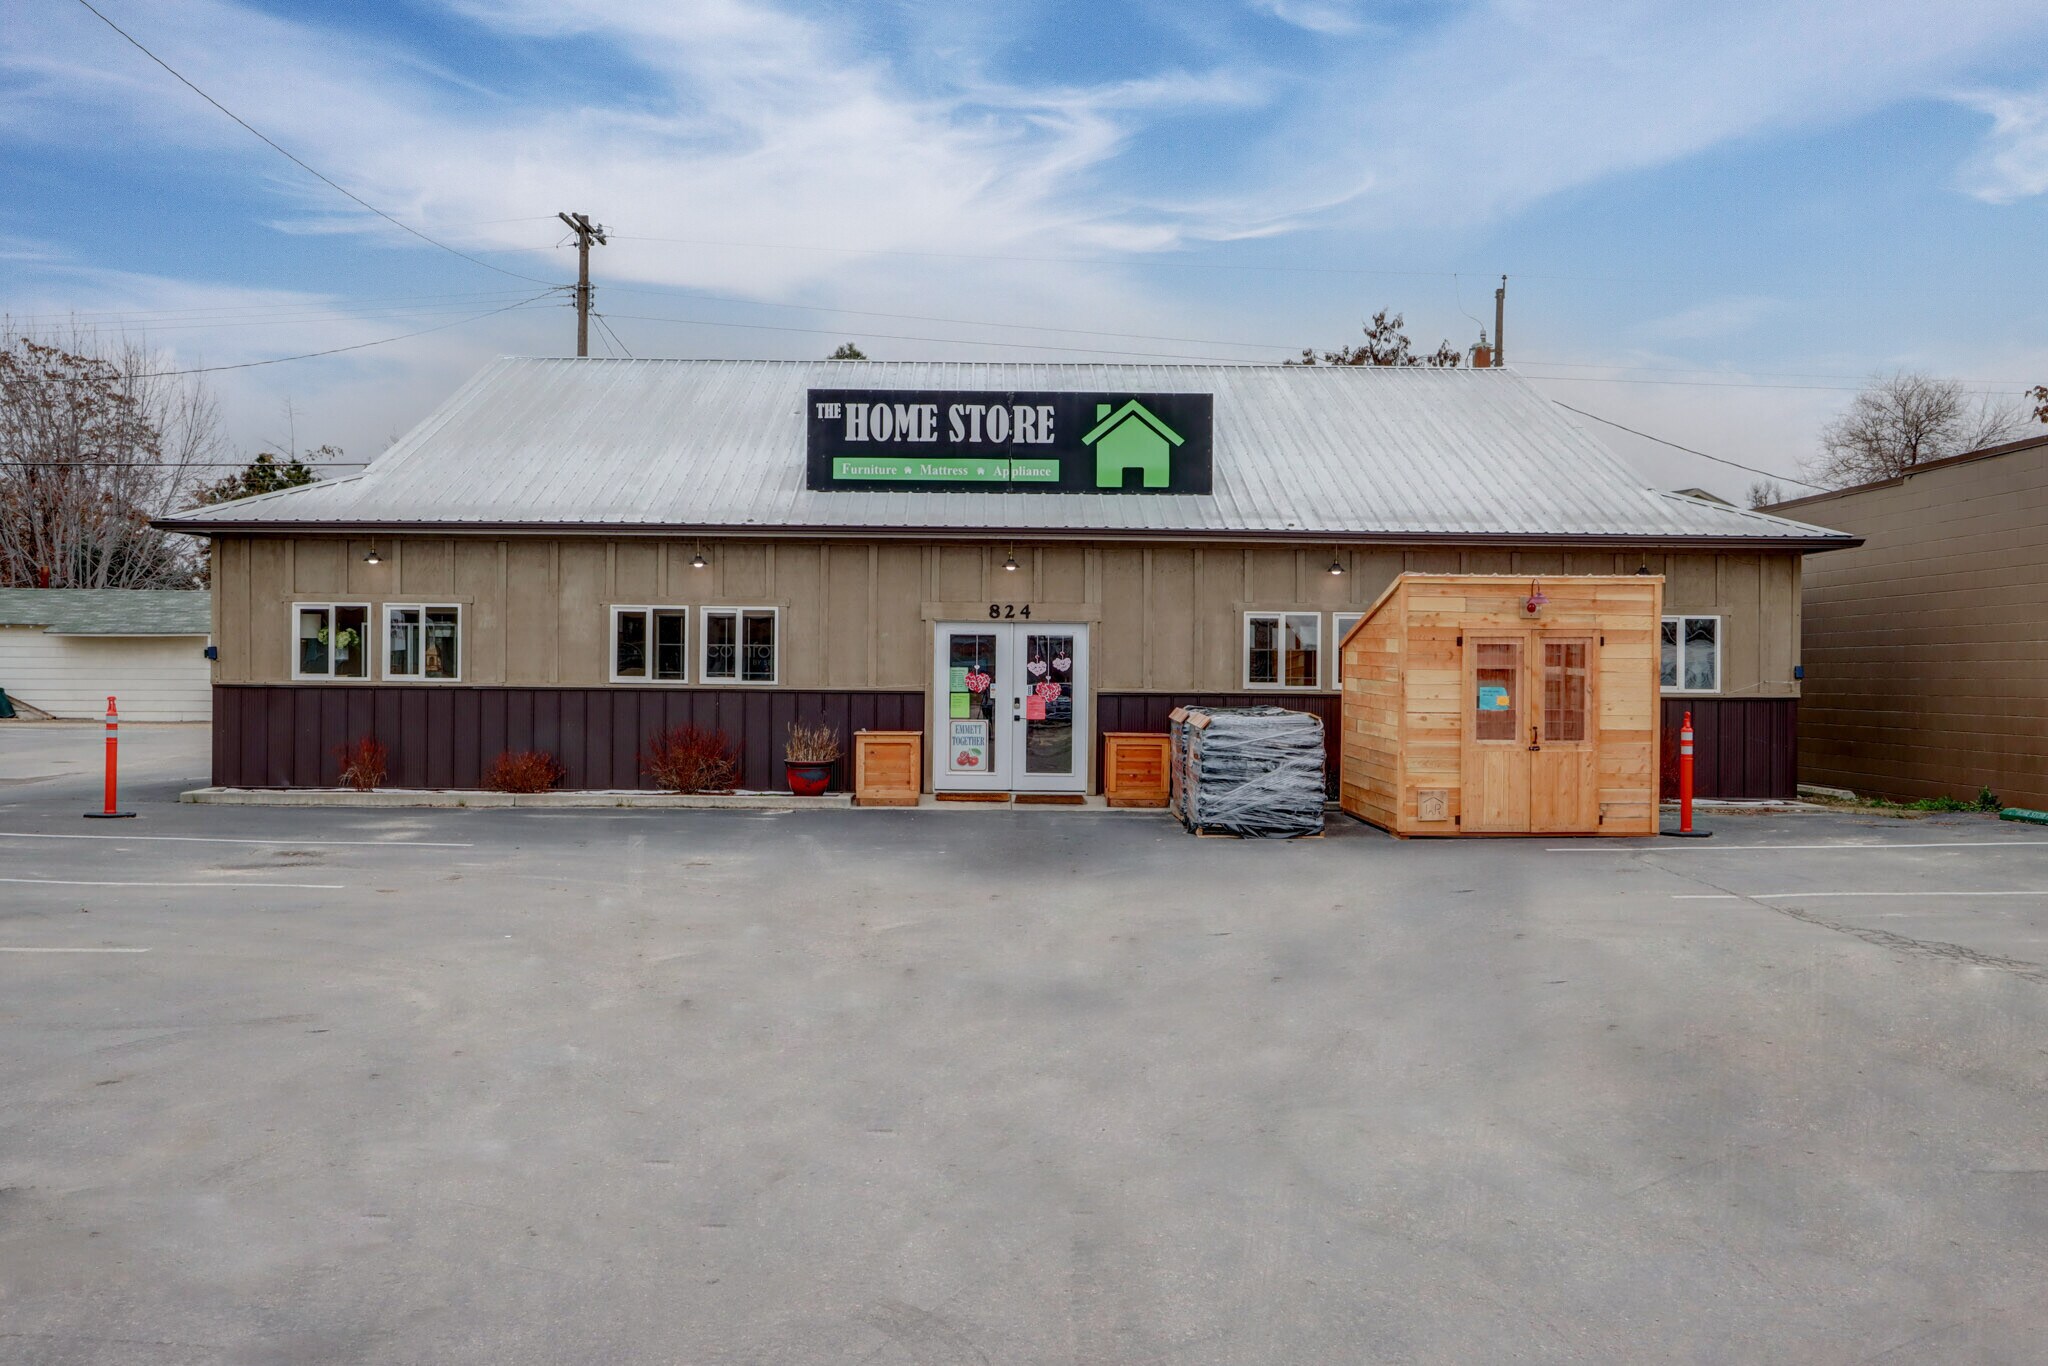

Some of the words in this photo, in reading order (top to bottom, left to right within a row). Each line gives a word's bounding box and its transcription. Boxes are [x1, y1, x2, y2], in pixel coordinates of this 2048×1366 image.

[816, 403, 841, 419] THE
[844, 403, 938, 442] HOME
[948, 404, 1056, 444] STORE
[842, 463, 897, 475] Furniture
[920, 464, 968, 477] Mattress
[993, 465, 1052, 479] Appliance
[989, 604, 1031, 619] 824
[955, 724, 982, 735] EMMETT
[952, 737, 985, 746] TOGETHER
